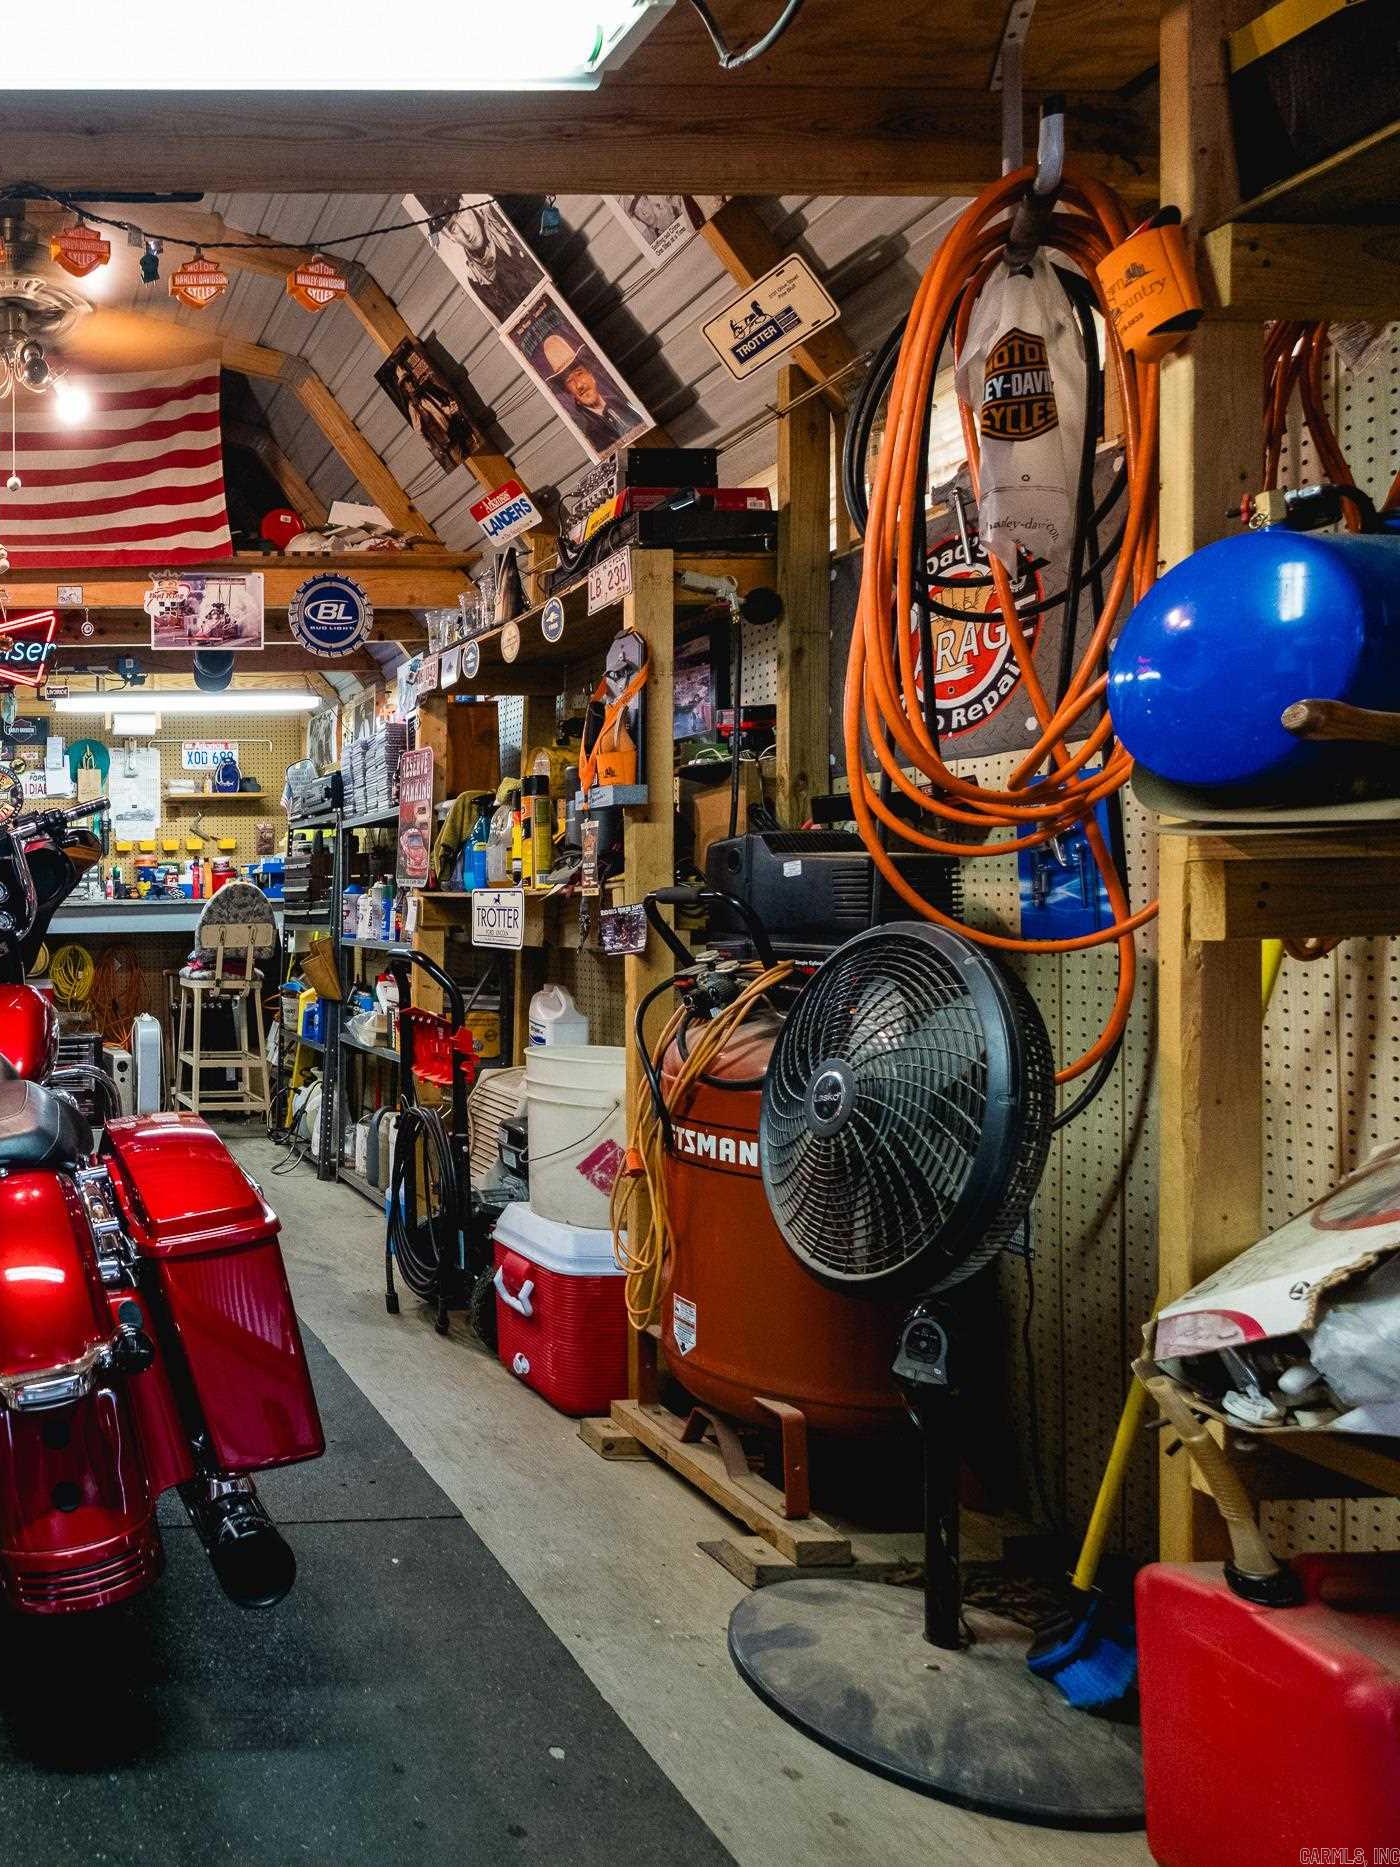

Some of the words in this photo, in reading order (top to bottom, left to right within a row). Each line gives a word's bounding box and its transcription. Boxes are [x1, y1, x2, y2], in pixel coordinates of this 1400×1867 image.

[187, 263, 217, 273] MOTOR
[308, 263, 337, 275] MOTOR
[174, 274, 227, 286] HARLEY-DAVIDSON
[295, 275, 347, 290] HARLEY-DAVIDSON
[187, 286, 218, 300] CYCLES
[306, 290, 335, 304] CYCLES
[735, 325, 778, 358] TROTTER
[481, 496, 533, 538] LANDERS
[926, 536, 990, 575] Dad's
[607, 563, 628, 591] 230
[317, 602, 353, 620] BL
[950, 657, 1022, 731] Repai
[476, 906, 520, 929] TROTTER
[813, 1091, 842, 1104] Lasko
